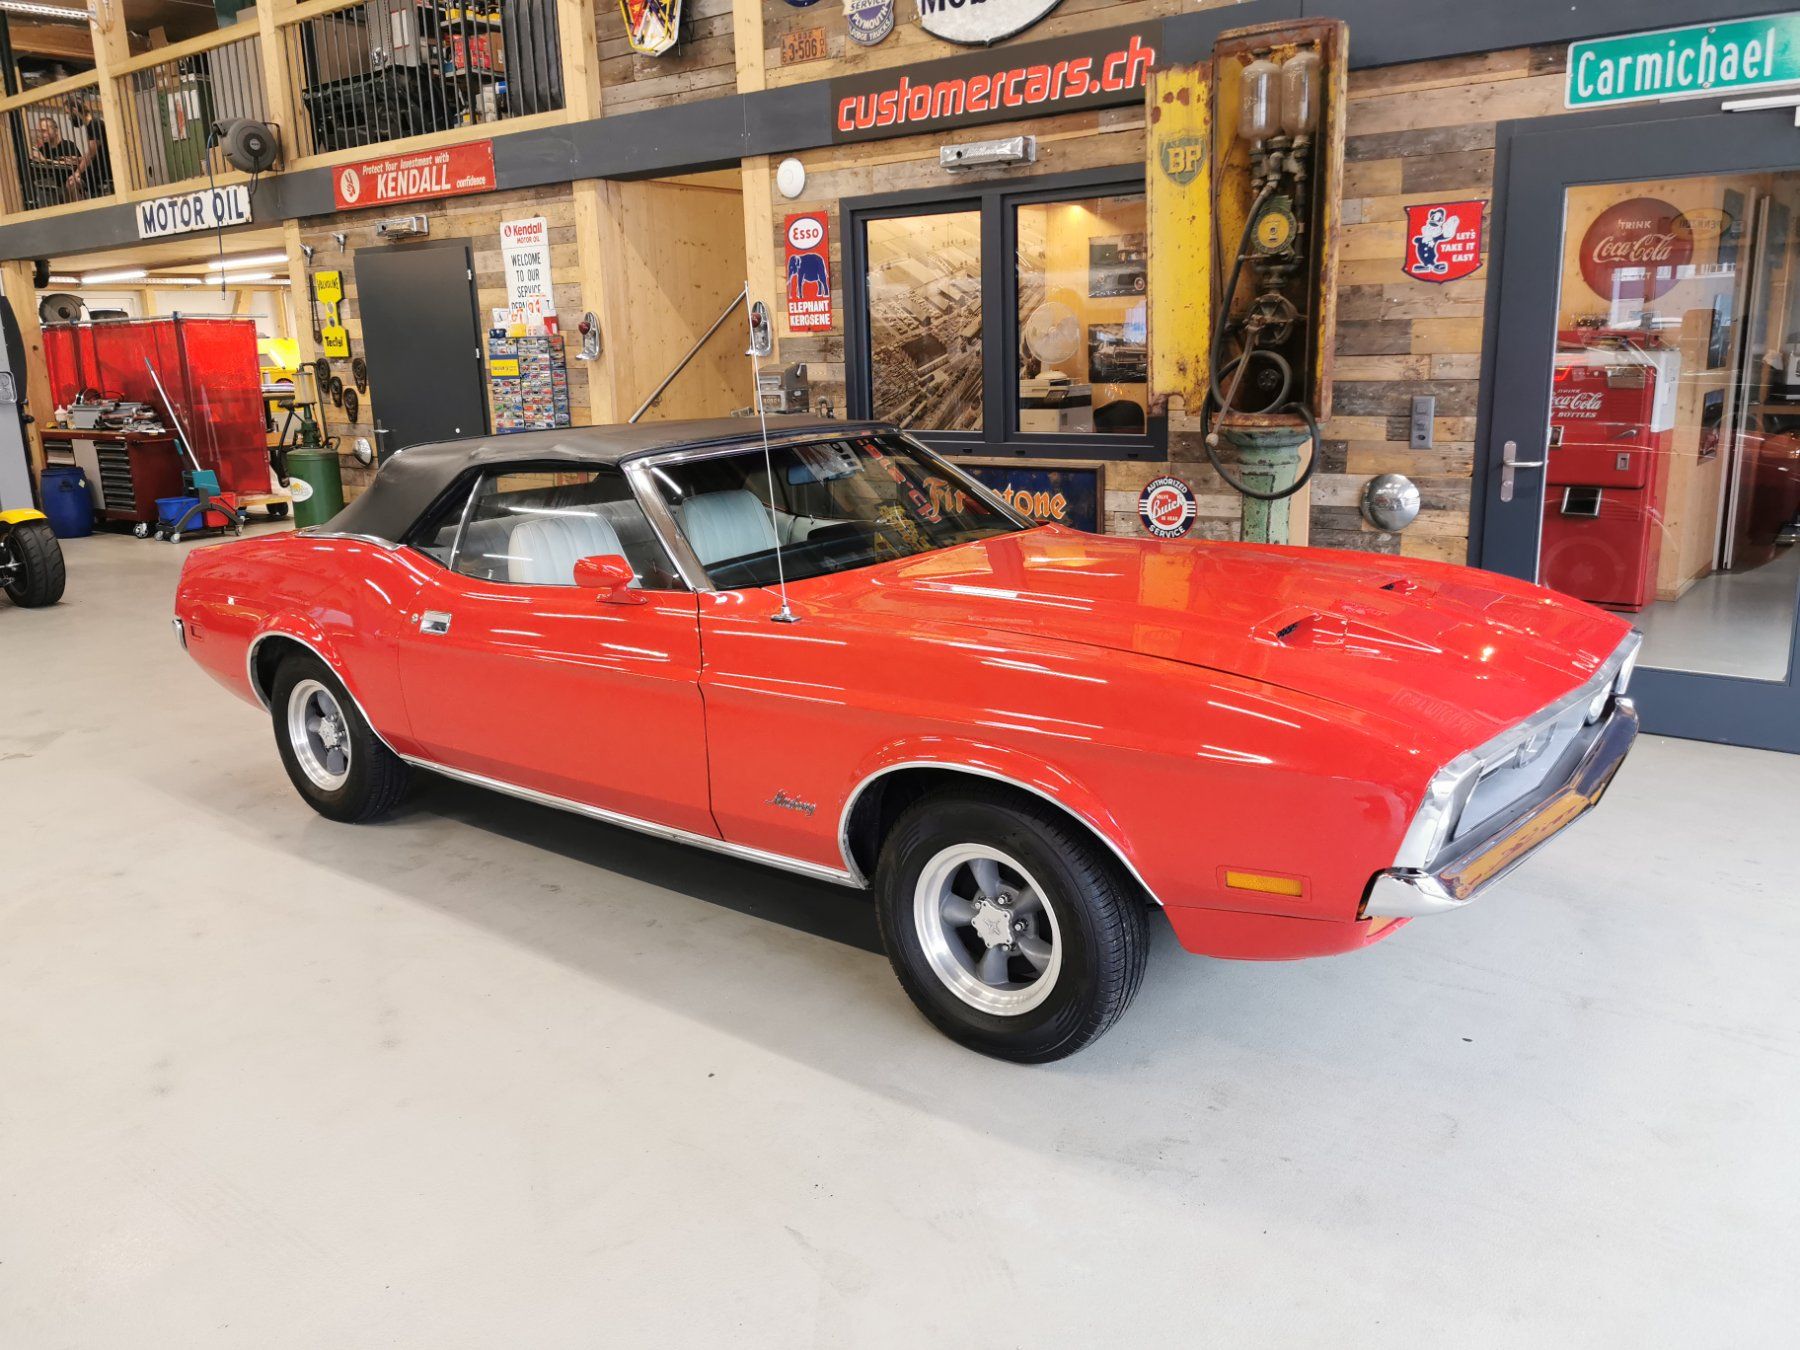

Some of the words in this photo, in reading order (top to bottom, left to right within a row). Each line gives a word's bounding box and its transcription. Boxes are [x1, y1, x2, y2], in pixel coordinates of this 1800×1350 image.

[849, 0, 886, 11] SERVI
[852, 6, 888, 29] PLYMOUTH
[1577, 27, 1776, 98] Carmichael
[837, 34, 1155, 132] customercars.ch
[362, 163, 383, 176] Protect
[385, 161, 398, 172] Your
[400, 155, 433, 170] Investment
[435, 152, 450, 164] with
[1167, 144, 1201, 174] BP
[376, 164, 451, 199] KENDALL
[456, 175, 486, 189] confidence
[141, 196, 205, 234] MOTOR
[213, 189, 244, 222] OIL
[513, 222, 542, 236] Kendall
[1456, 228, 1476, 240] LET'S
[516, 236, 532, 244] MOTOR
[1440, 243, 1463, 253] TAKE
[1466, 242, 1475, 251] IT
[1592, 233, 1677, 264] Coca-Cola
[511, 252, 542, 267] WELCOME
[1452, 254, 1474, 263] EASY
[516, 270, 524, 282] TO
[527, 268, 540, 281] OUR
[788, 300, 830, 314] ELEPHANT
[789, 313, 831, 327] KEROSENE
[1552, 391, 1605, 411] ca-Cola
[1147, 477, 1188, 494] AUTHORIZED
[1152, 493, 1183, 518] Buick
[1148, 524, 1186, 538] SERVICE
